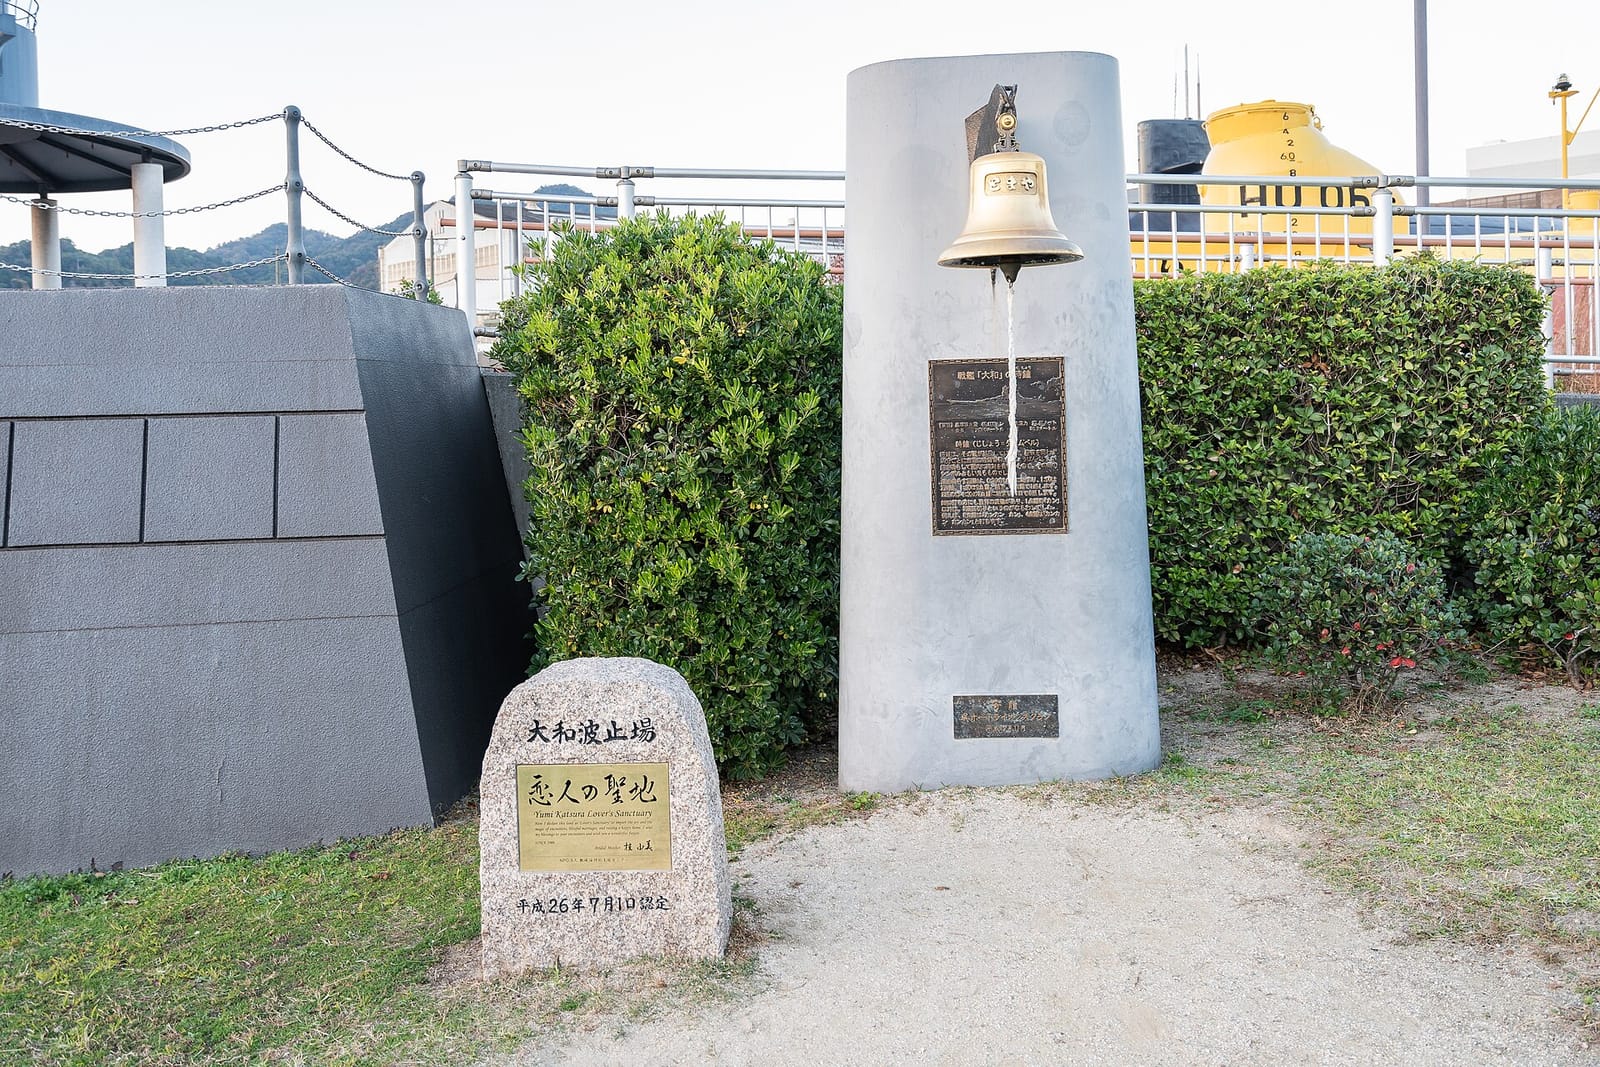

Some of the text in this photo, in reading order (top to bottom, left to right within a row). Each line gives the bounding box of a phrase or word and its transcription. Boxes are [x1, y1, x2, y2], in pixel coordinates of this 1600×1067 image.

[1282, 111, 1289, 121] 6
[1287, 139, 1295, 147] 2
[527, 717, 657, 745] 大和波止場
[528, 774, 657, 806] 恋人の聖地
[534, 809, 652, 819] Yumi Katsura Lover's Sanctuary
[516, 896, 671, 915] 平成26年7月1日認定
